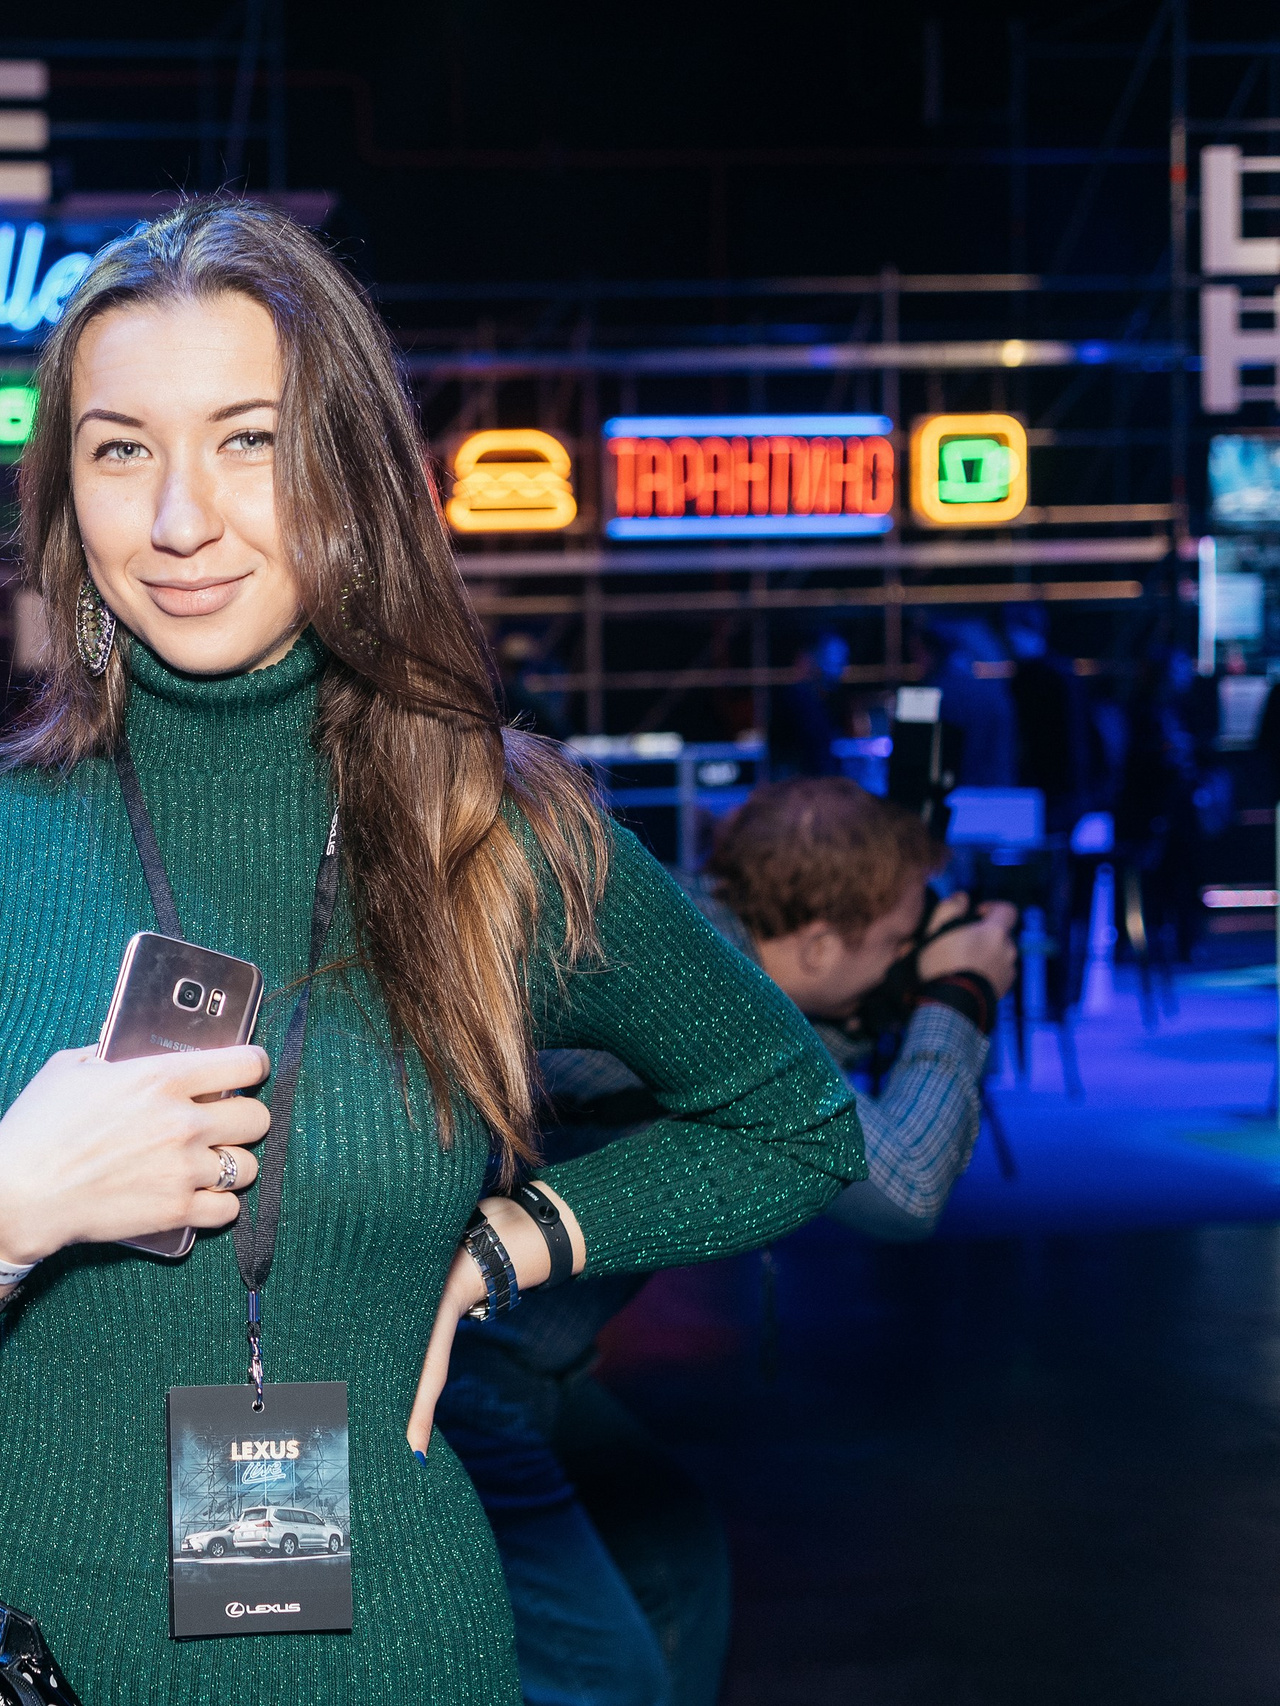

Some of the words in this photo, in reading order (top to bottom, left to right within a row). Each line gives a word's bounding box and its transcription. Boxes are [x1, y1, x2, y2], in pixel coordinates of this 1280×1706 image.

[608, 436, 895, 518] ТАРАНТИНО
[231, 1440, 300, 1461] LEXUS
[241, 1461, 287, 1485] Live
[245, 1602, 301, 1614] LEXUS
